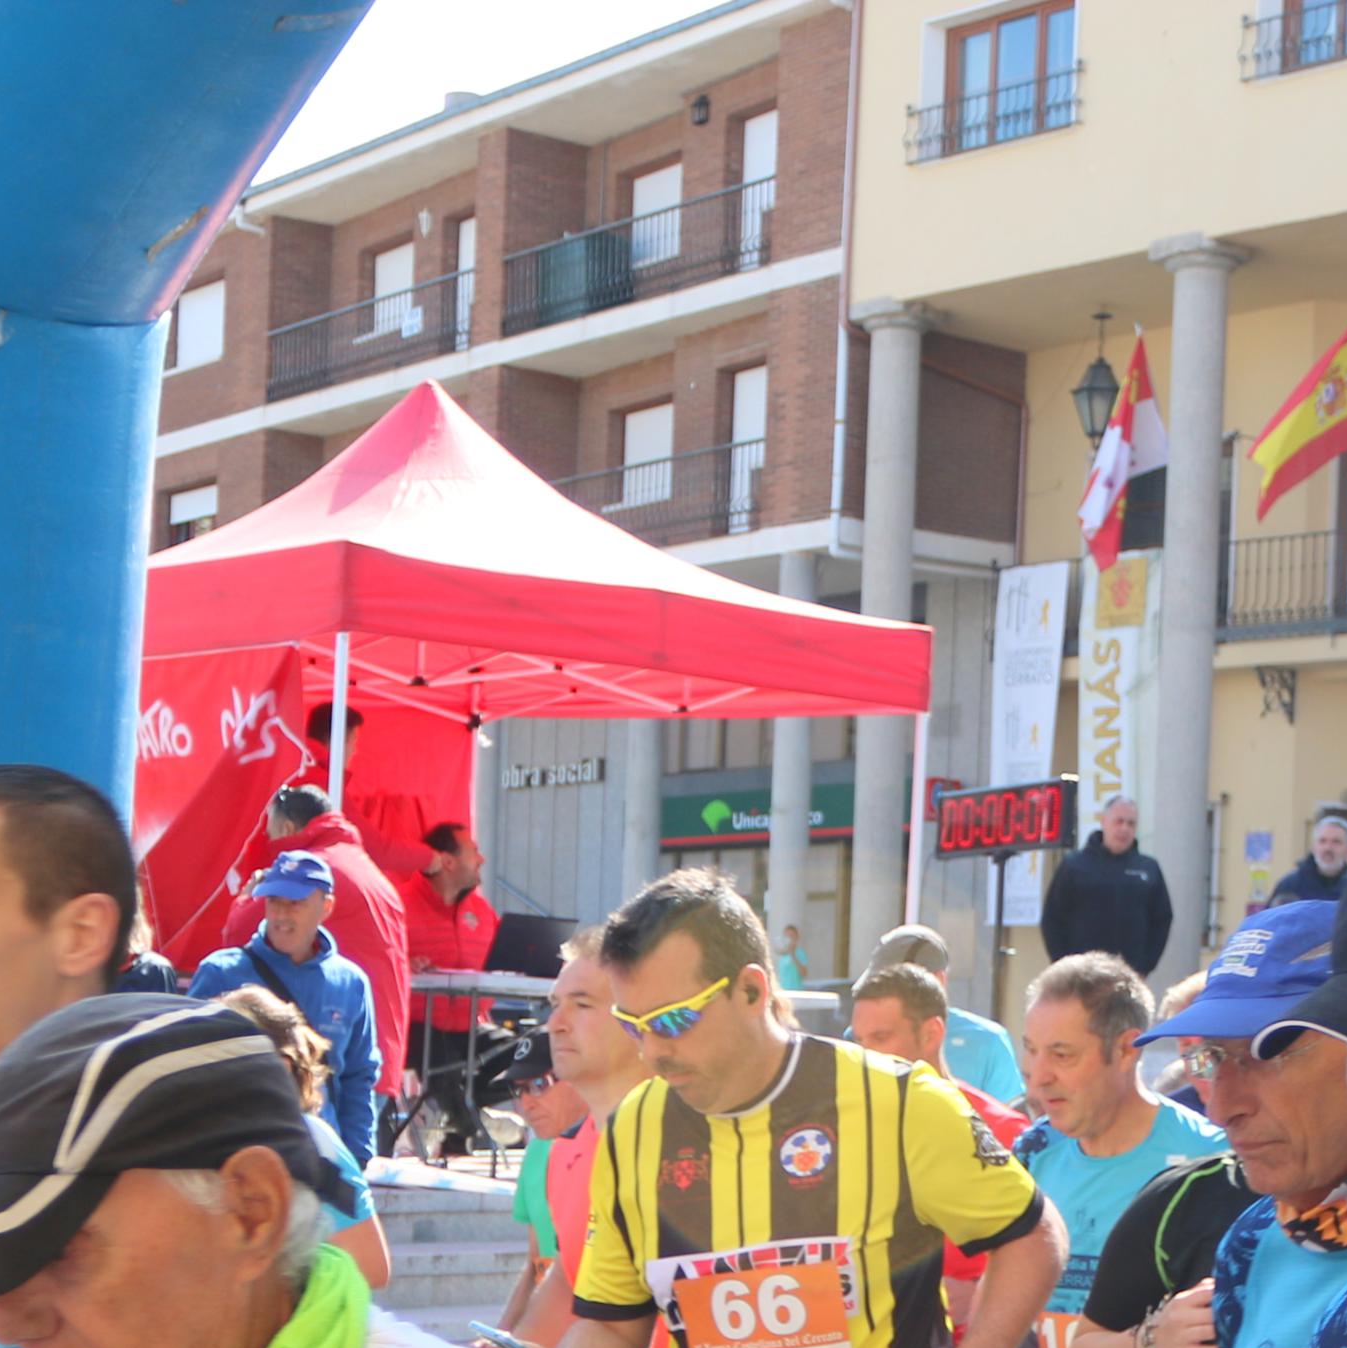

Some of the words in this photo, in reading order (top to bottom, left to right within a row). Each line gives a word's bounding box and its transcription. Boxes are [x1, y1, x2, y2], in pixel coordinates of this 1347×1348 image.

[1085, 638, 1123, 822] TANÁS
[502, 765, 541, 789] obra
[547, 757, 603, 784] social
[711, 1274, 807, 1340] 66
[802, 1331, 843, 1345] Cerrato
